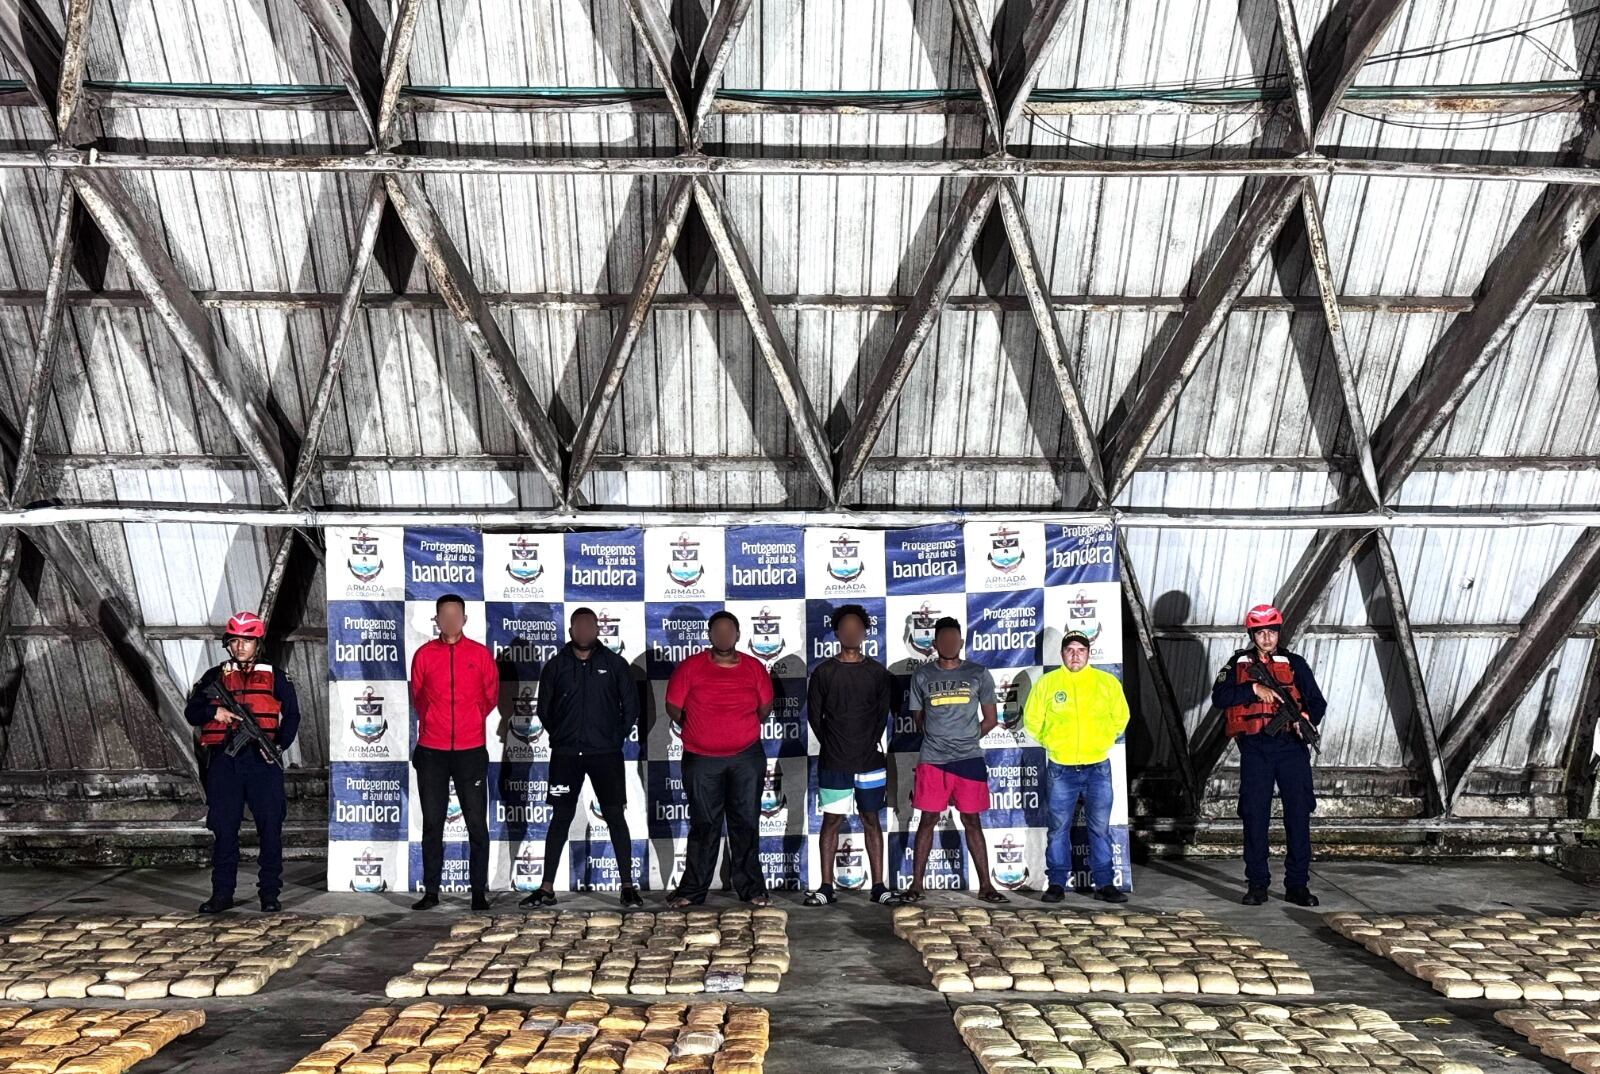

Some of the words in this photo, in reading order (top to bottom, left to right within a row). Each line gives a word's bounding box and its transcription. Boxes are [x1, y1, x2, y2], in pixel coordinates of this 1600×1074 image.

[1106, 532, 1112, 541] la
[420, 541, 475, 554] Protegemos
[581, 544, 636, 556] Protegemos
[742, 542, 796, 555] Protegemos
[902, 540, 956, 552] Protegemos
[436, 553, 442, 561] el
[443, 553, 458, 561] azul
[458, 553, 468, 561] de
[468, 554, 476, 562] la
[918, 551, 924, 559] el
[925, 551, 939, 559] azul
[940, 550, 948, 558] de
[950, 549, 956, 557] la
[1053, 545, 1112, 568] bandera
[598, 556, 604, 565] el
[605, 556, 618, 565] azul
[620, 556, 628, 565] de
[630, 556, 636, 565] la
[758, 555, 764, 564] el
[765, 555, 779, 564] azul
[780, 555, 788, 564] de
[790, 555, 796, 563] la
[412, 560, 475, 582] bandera
[893, 560, 957, 578] bandera
[572, 565, 636, 586] bandera
[732, 564, 796, 586] bandera
[985, 575, 1026, 583] ARMADA
[346, 584, 385, 593] ARMADA
[504, 586, 544, 594] ARMADA
[825, 583, 866, 591] ARMADA
[984, 607, 1036, 620] Protegemos
[344, 617, 396, 631] Protegemos
[503, 618, 556, 631] Protegemos
[998, 620, 1004, 628] el
[1005, 619, 1018, 628] azul
[1020, 618, 1028, 626] de
[1030, 617, 1036, 626] la
[361, 630, 368, 639] el
[369, 630, 382, 640] azul
[383, 631, 390, 640] de
[390, 631, 396, 640] la
[527, 631, 540, 640] azul
[541, 632, 550, 640] de
[551, 632, 557, 640] la
[679, 631, 684, 640] el
[686, 631, 700, 640] azul
[872, 626, 878, 635] la
[973, 628, 1036, 651] bandera
[336, 640, 398, 662] bandera
[814, 637, 878, 658] banra
[347, 778, 400, 792] Protegemos
[1000, 778, 1006, 787] el
[1007, 778, 1020, 787] azul
[1022, 777, 1031, 786] de
[1032, 777, 1038, 786] la
[362, 791, 368, 800] el
[370, 791, 383, 800] azul
[384, 791, 393, 800] de
[394, 791, 400, 800] la
[528, 791, 541, 801] azul
[336, 800, 400, 822] bandera
[762, 864, 768, 873] el
[770, 864, 783, 873] azul
[794, 864, 800, 872] la
[929, 861, 943, 869] azul
[954, 860, 960, 868] la
[442, 870, 448, 880] el
[449, 870, 463, 880] azul
[602, 869, 608, 878] el
[635, 868, 640, 877] la
[765, 872, 800, 890] dera
[897, 870, 960, 889] badera
